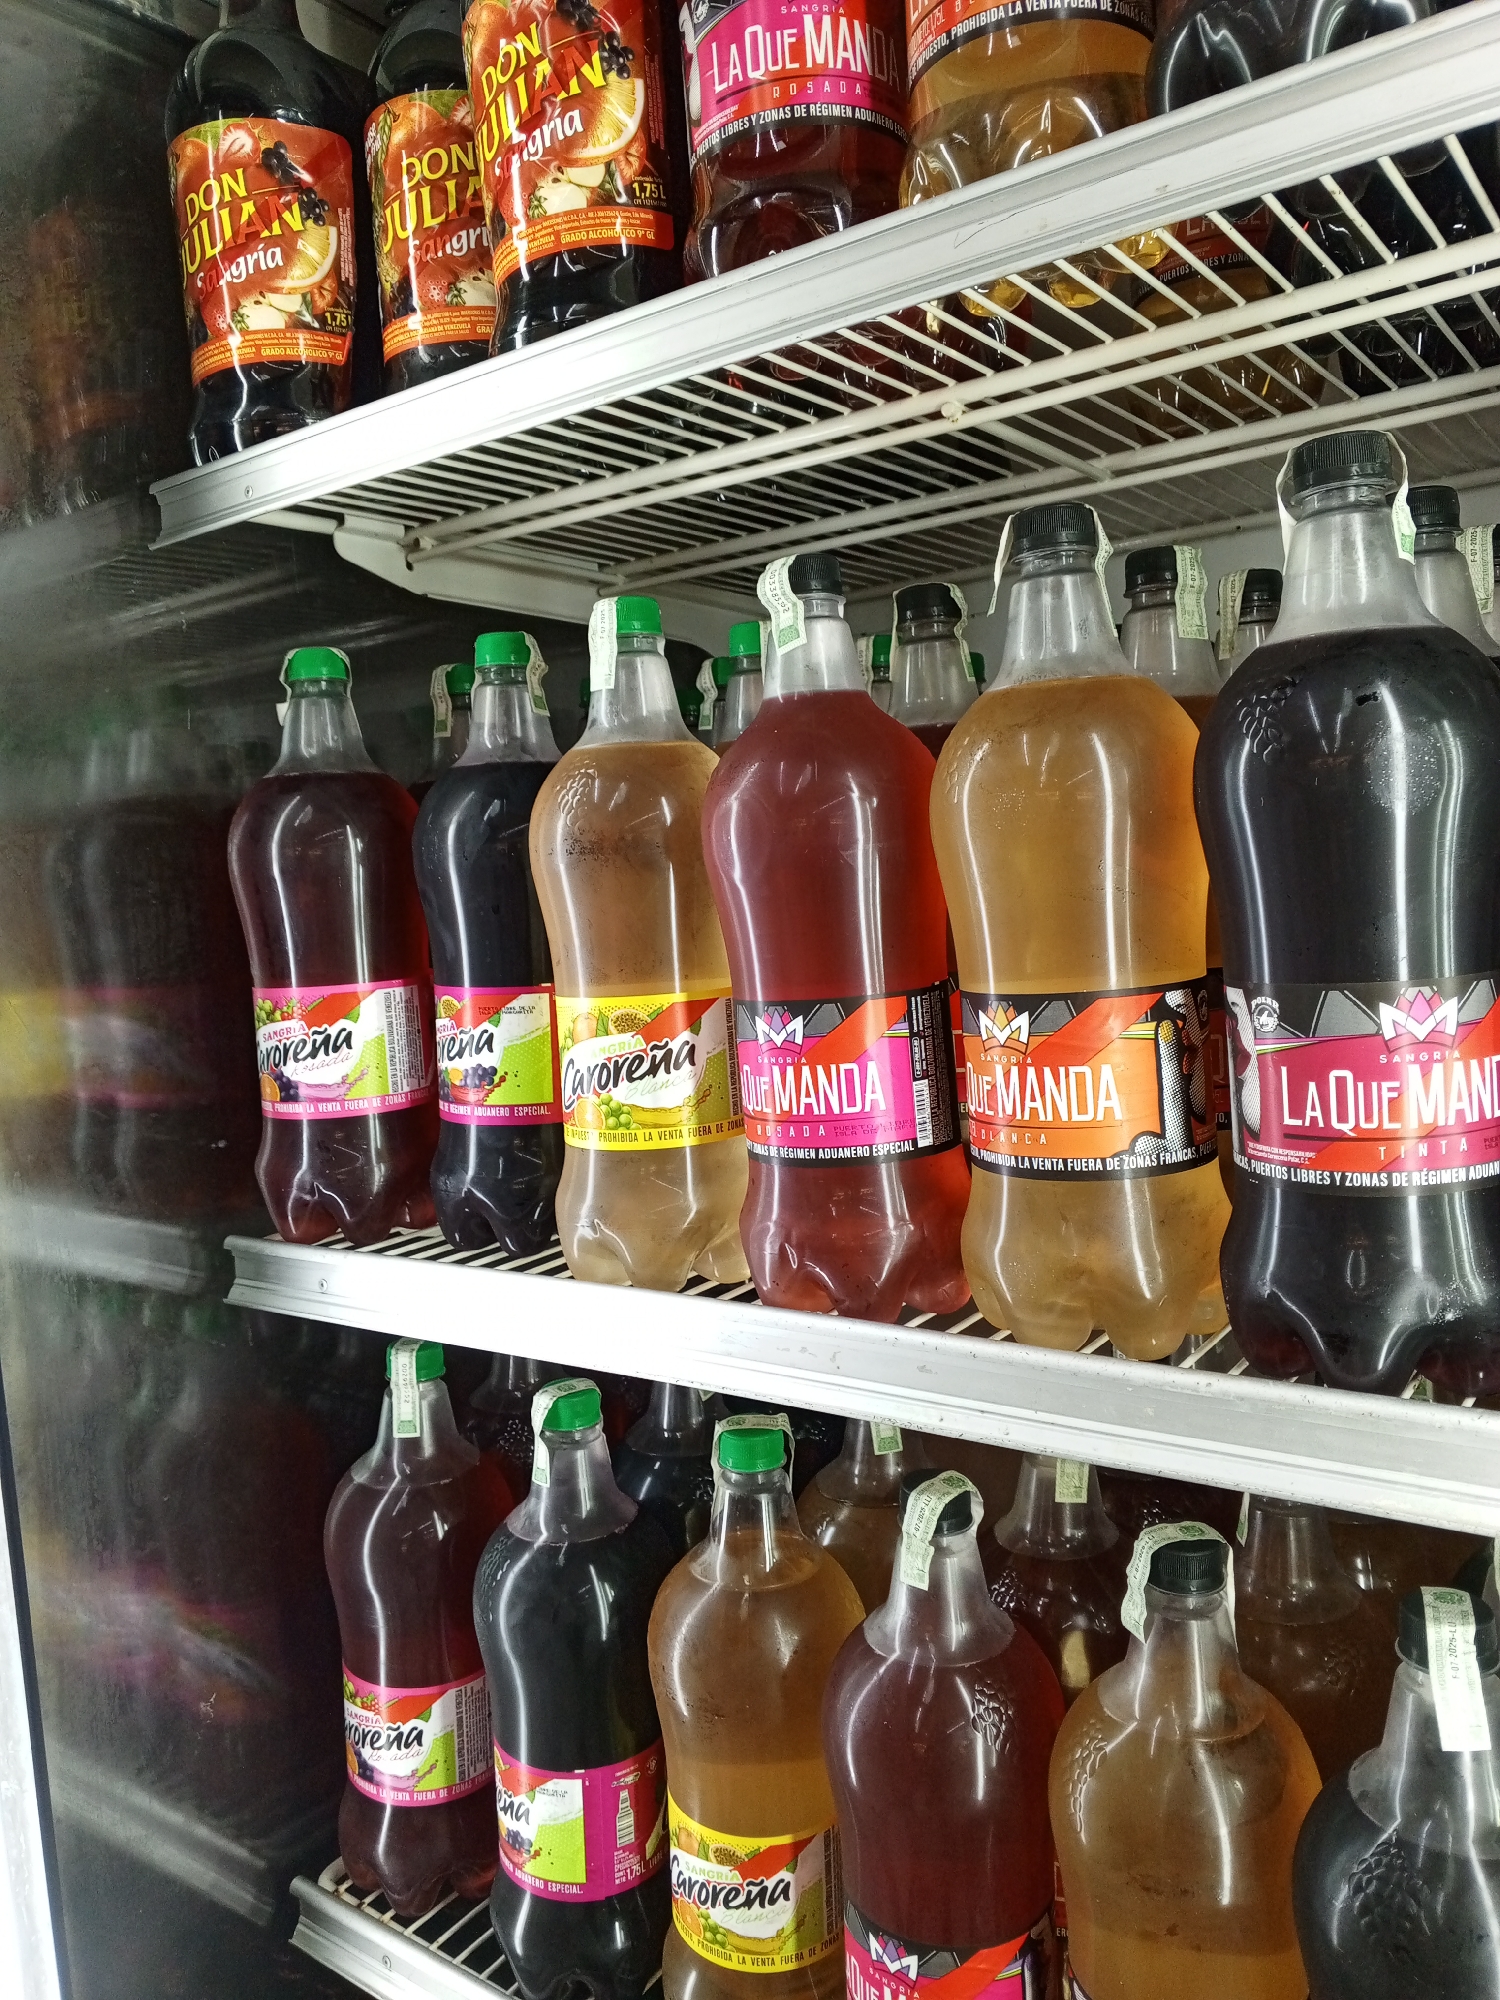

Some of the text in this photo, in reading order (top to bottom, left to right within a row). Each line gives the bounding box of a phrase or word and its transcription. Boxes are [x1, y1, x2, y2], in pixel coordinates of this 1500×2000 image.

[781, 5, 845, 15] SANGRIA
[951, 6, 1005, 37] PROHIBIDA
[1008, 2, 1023, 17] LA
[481, 22, 542, 106] DON
[773, 80, 862, 99] ROSADA
[477, 39, 607, 187] JULIAN
[721, 115, 750, 141] LIBRES
[751, 111, 759, 126] Y
[758, 106, 792, 125] ZONAS
[794, 104, 812, 118] DE
[815, 101, 852, 119] RÉGIMEN
[854, 108, 894, 132] ADUANERO
[402, 142, 475, 190] DON
[185, 168, 247, 225] DON
[182, 193, 304, 290] JULIAN
[560, 232, 587, 245] GRADO
[1159, 263, 1190, 283] PUERTOS
[1228, 251, 1252, 264] ZONA
[261, 347, 284, 356] GRADO
[1250, 996, 1280, 1012] POLAR
[258, 1026, 354, 1073] aroreña
[757, 1056, 807, 1064] SANGRIA
[926, 1036, 936, 1075] BOLIVARIANA
[980, 1053, 1032, 1064] SANGRIA
[1379, 1051, 1461, 1064] SANGRIA
[563, 1040, 697, 1111] Caroreña
[771, 1060, 887, 1116] MANDA
[306, 1103, 315, 1113] LA
[318, 1101, 341, 1113] VENTA
[345, 1099, 369, 1111] FUERA
[372, 1097, 381, 1108] DE
[384, 1092, 406, 1106] ZONAS
[994, 1064, 1123, 1122] MANDA
[474, 1106, 510, 1117] ADUANERO
[514, 1106, 551, 1116] ESPECIAL.
[599, 1132, 639, 1143] PROHIBIDA
[643, 1131, 654, 1142] LA
[657, 1129, 684, 1141] VENTA
[688, 1127, 712, 1138] FUERA
[715, 1124, 724, 1134] DE
[727, 1118, 744, 1132] ZONAS
[757, 1124, 826, 1138] ROSADA
[981, 1132, 1047, 1145] BLANCA
[770, 1146, 779, 1158] DE
[780, 1144, 816, 1159] RÉGIMEN
[818, 1145, 870, 1160] ADUANERO
[872, 1139, 914, 1156] ESPECIAL
[980, 1147, 1198, 1172] PROHIBIDA LA VENTA FUERA DE ZONAS FRANCAS,
[1378, 1137, 1468, 1160] TINTA
[1251, 1159, 1466, 1187] PUERTOS LIBRES Y ZONAS DE RÉGIMEN
[389, 1790, 411, 1801] VENTA
[413, 1790, 437, 1801] FUERA
[439, 1787, 448, 1798] DE
[451, 1781, 473, 1796] ZONAS
[548, 1882, 584, 1895] ESPECIAL.
[671, 1854, 791, 1911] Caroreña
[697, 1934, 841, 1968] PROHIBIDA LA VENTA FUERA DE ZONAS
